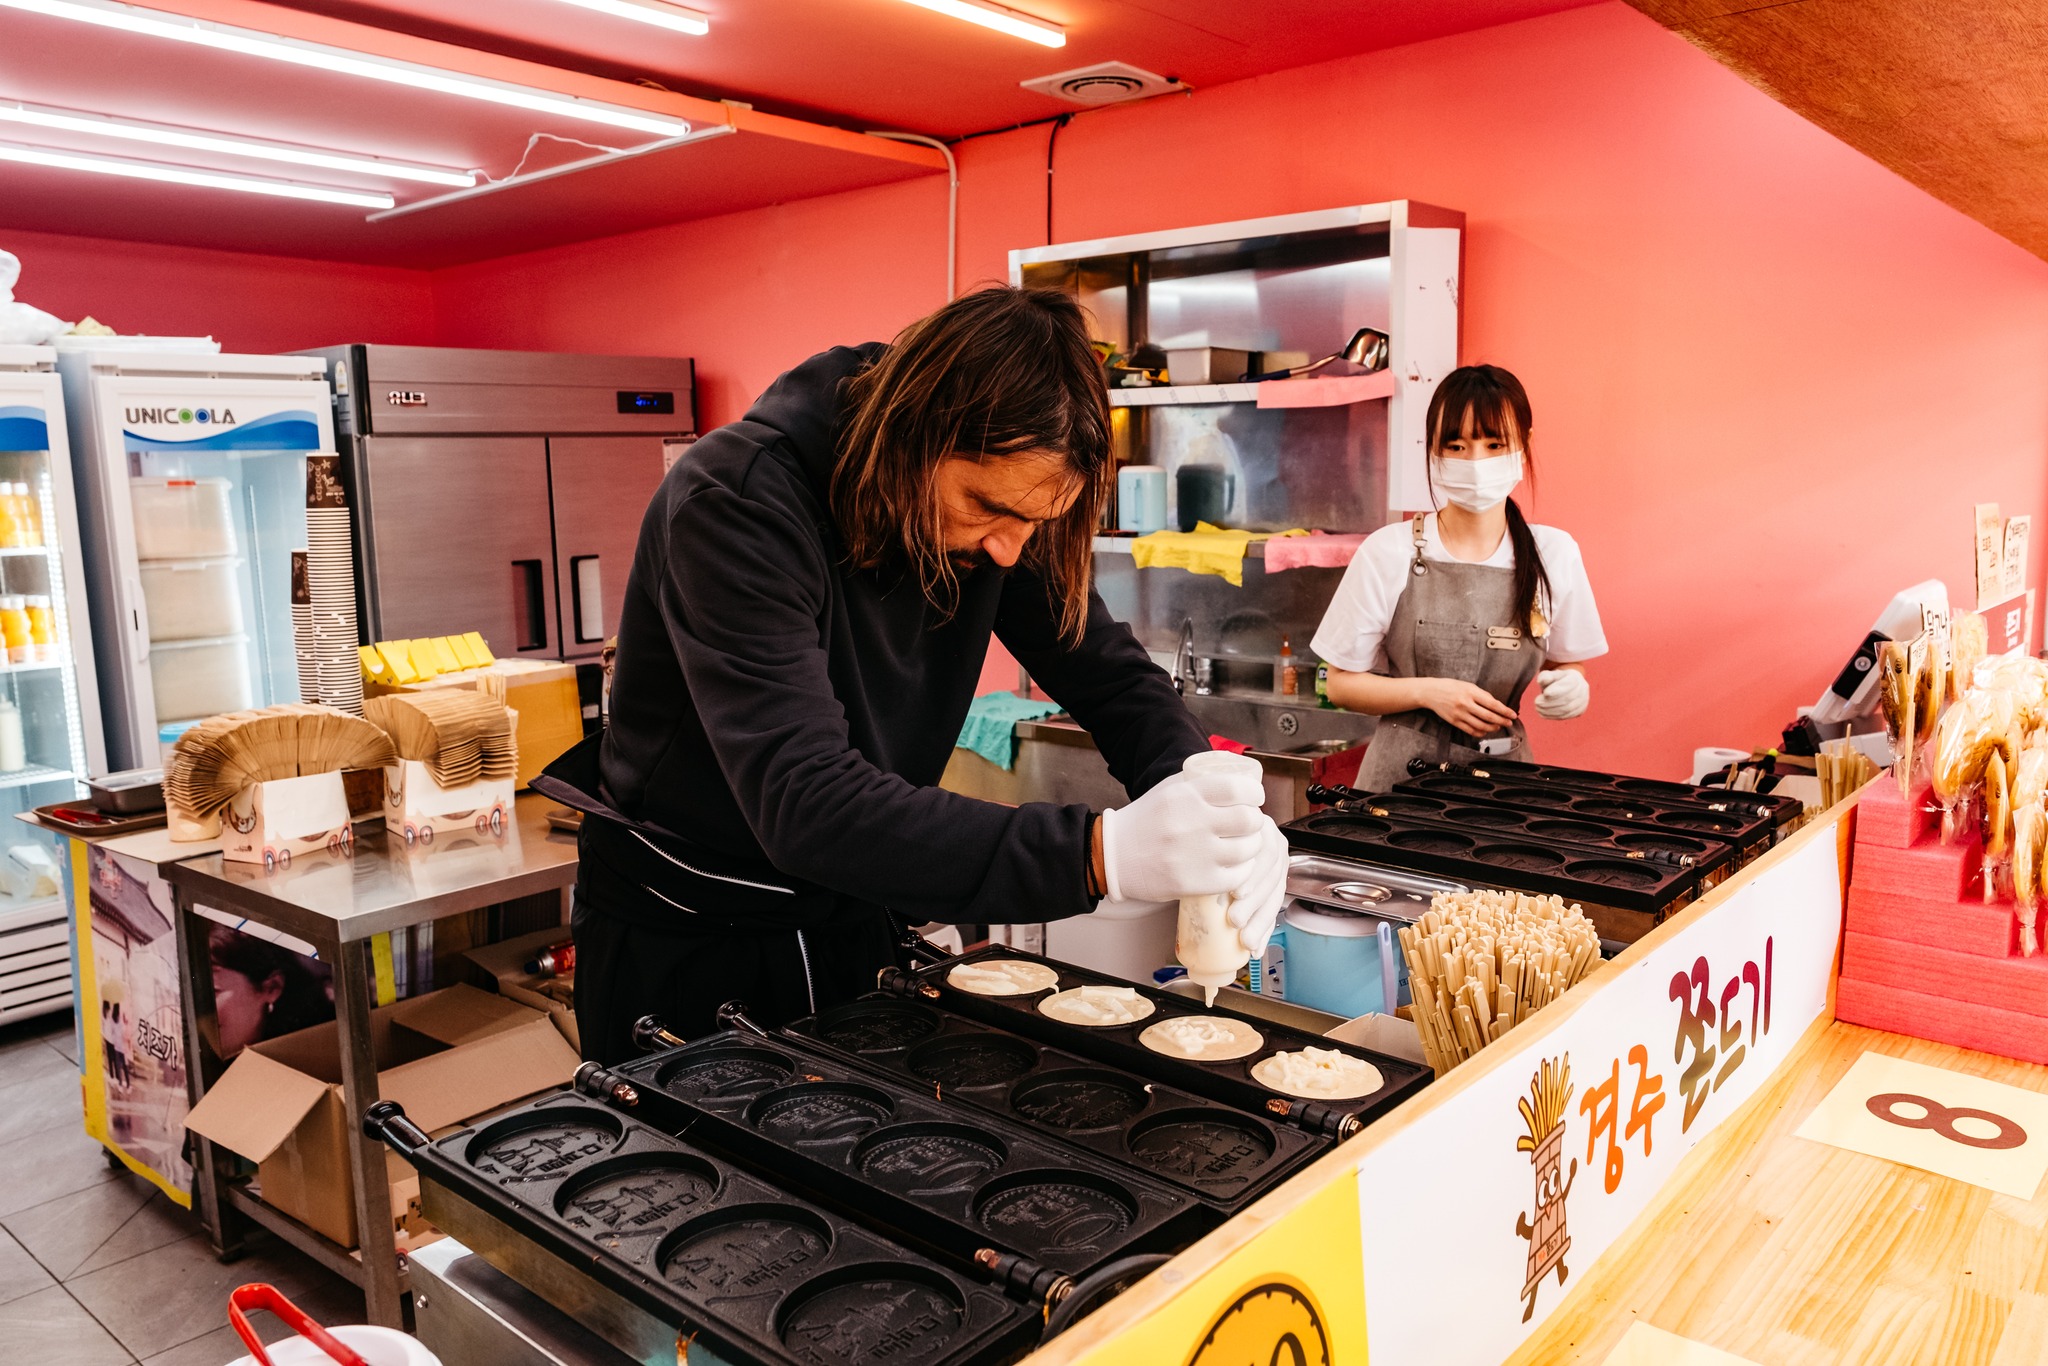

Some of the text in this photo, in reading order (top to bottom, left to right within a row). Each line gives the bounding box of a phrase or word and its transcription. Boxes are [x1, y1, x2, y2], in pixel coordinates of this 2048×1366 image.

[124, 407, 237, 425] UNICOOLA
[137, 1018, 177, 1071] 치즈가
[1579, 935, 1773, 1195] 경주 쫀드기
[1865, 1092, 2028, 1150] 8
